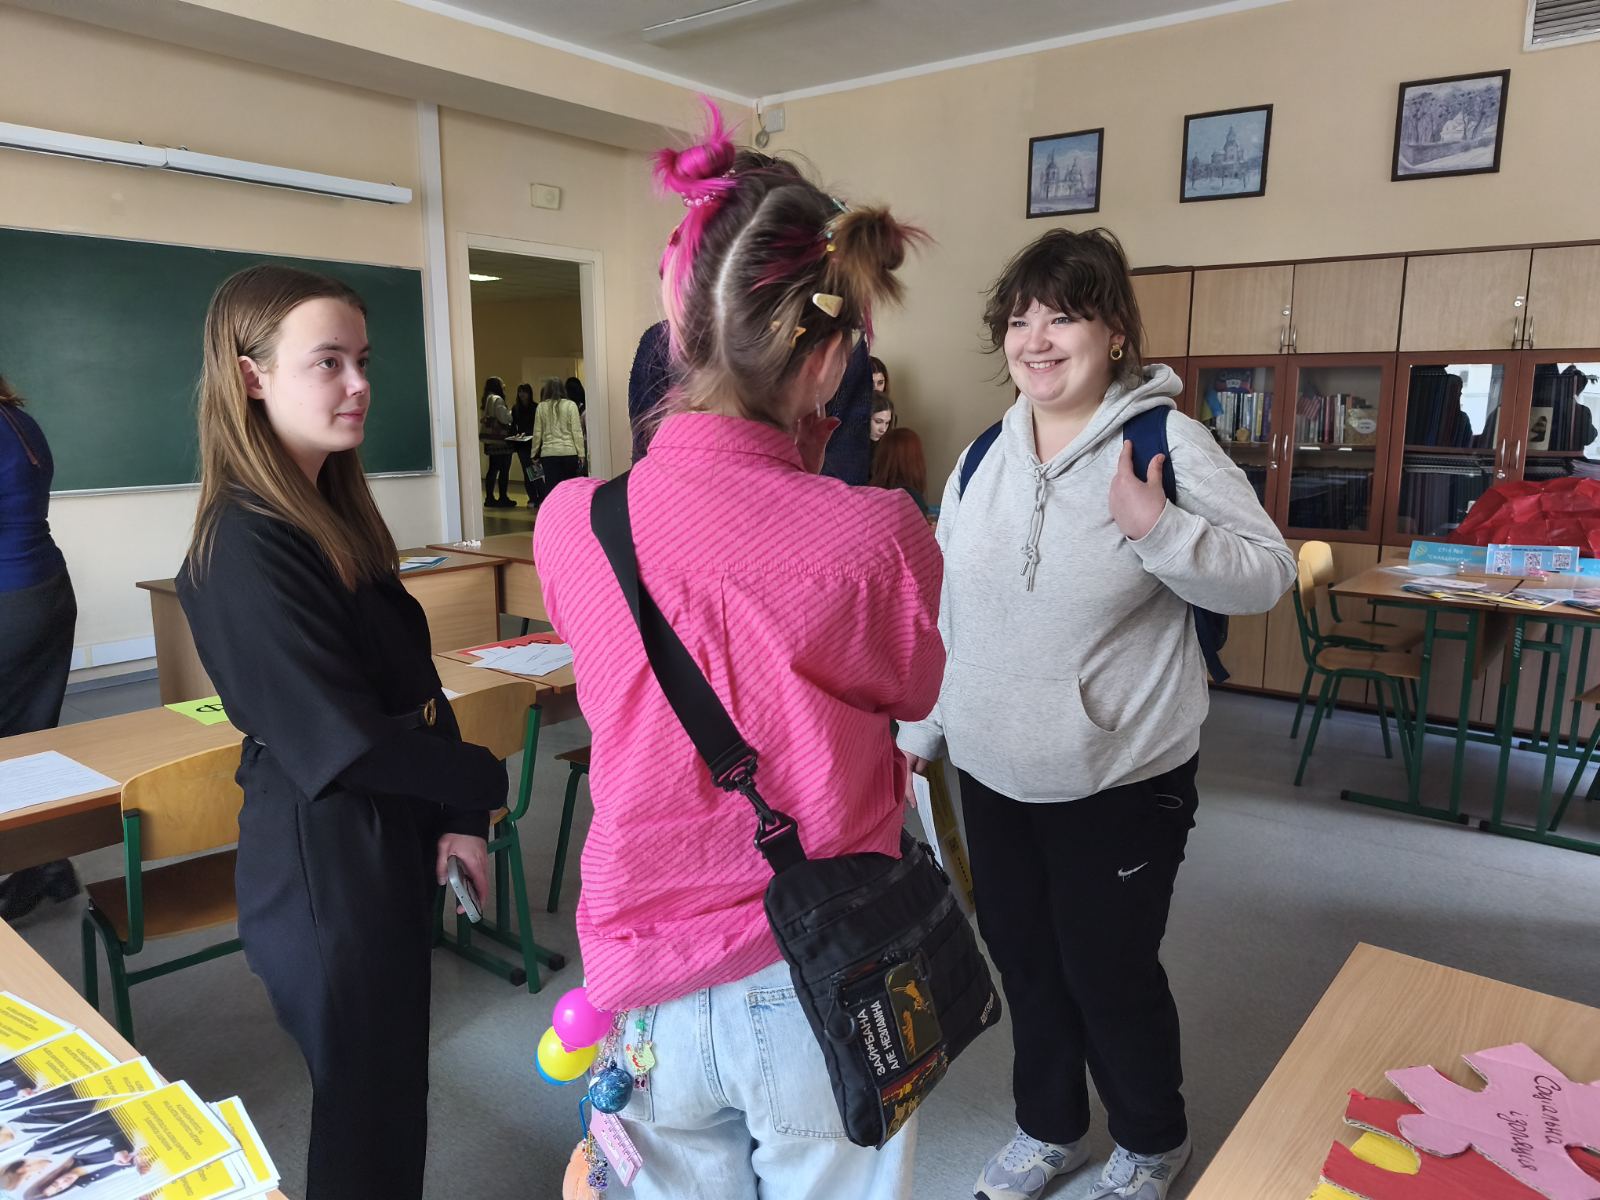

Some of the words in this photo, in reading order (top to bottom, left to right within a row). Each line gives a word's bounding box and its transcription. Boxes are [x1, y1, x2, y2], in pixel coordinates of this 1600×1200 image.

[870, 1000, 893, 1051] НЕЗЛАМНА
[885, 1049, 900, 1071] АЛЕ
[1532, 1075, 1564, 1144] Соціальна
